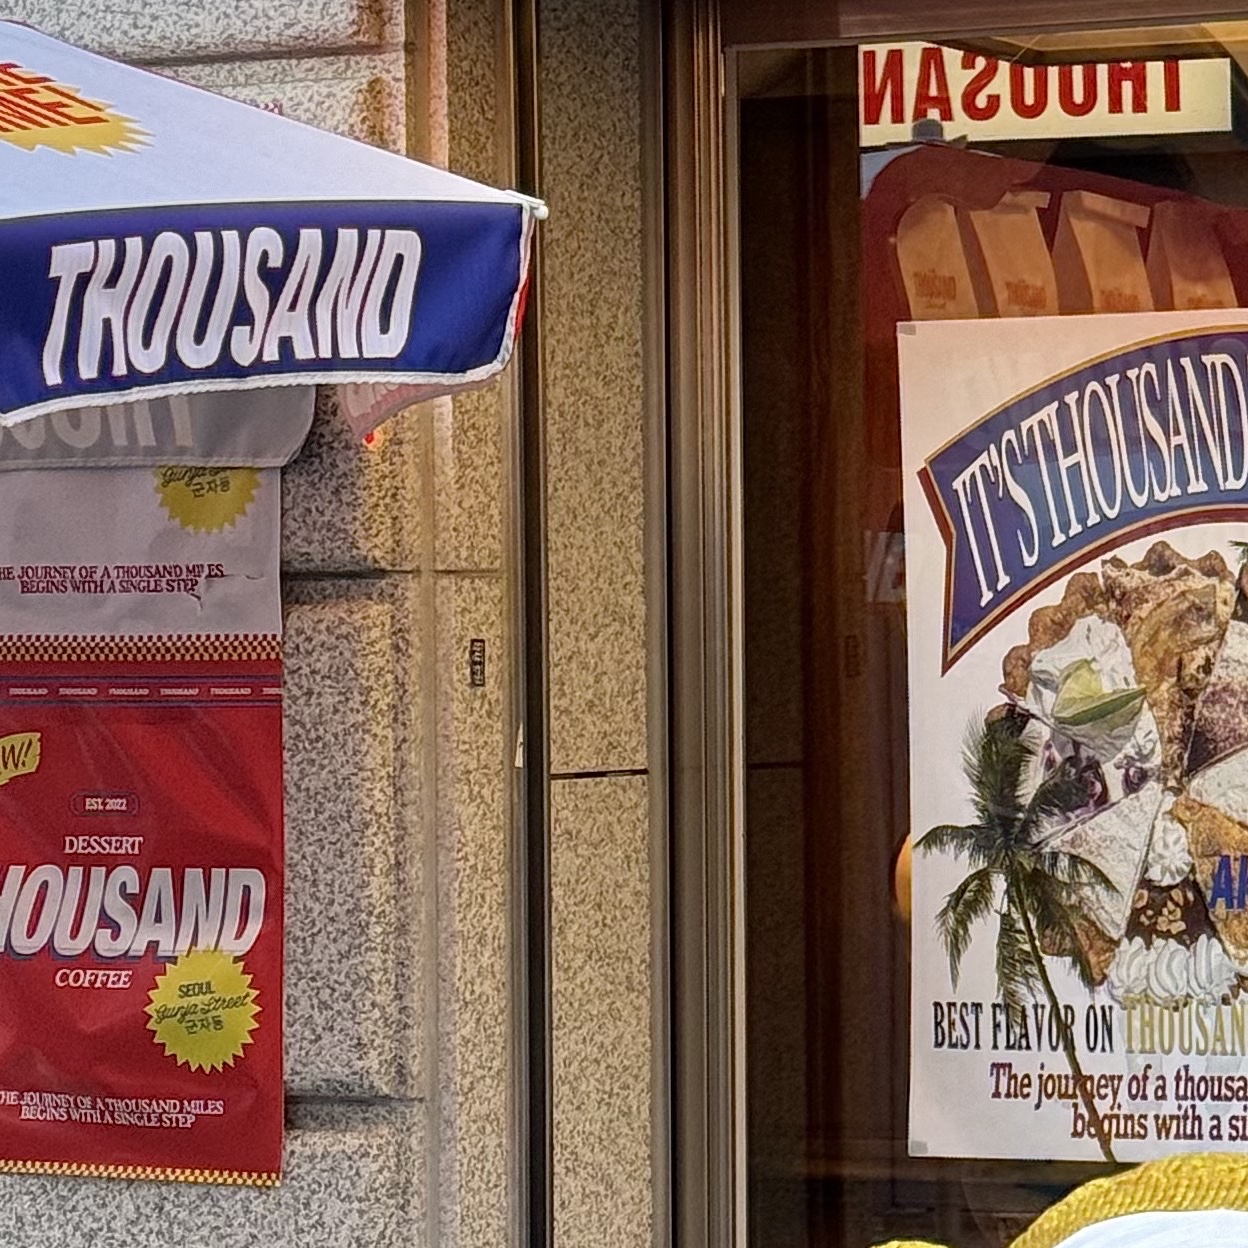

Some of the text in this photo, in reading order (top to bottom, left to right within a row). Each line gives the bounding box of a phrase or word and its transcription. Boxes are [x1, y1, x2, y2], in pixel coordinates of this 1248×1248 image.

[42, 227, 422, 386] THOUSAND
[951, 426, 1041, 608] IT'S
[17, 565, 76, 580] JOURNEY
[79, 565, 98, 580] OF
[101, 565, 111, 579] A
[113, 563, 183, 579] THOUSAND
[20, 579, 69, 594] BEGINS
[70, 580, 105, 594] WITH
[106, 580, 117, 594] A
[118, 579, 163, 594] SINGLE
[63, 835, 144, 855] DESSERT
[54, 968, 133, 989] COFFEE
[178, 980, 216, 999] SEOUL
[932, 1001, 983, 1052] BEST
[991, 1003, 1076, 1053] FLAVOR
[1086, 1004, 1114, 1054] ON
[989, 1062, 1032, 1101] The
[1033, 1069, 1123, 1109] journey
[1127, 1065, 1152, 1102] of
[1153, 1079, 1168, 1102] a
[20, 1091, 77, 1108] JOURNEY
[77, 1095, 93, 1109] OF
[95, 1097, 105, 1111] A
[105, 1098, 180, 1114] THOUSAND
[182, 1099, 225, 1115] MILES
[20, 1105, 197, 1129] BEGINS WITH A SINGLE STEP
[1070, 1103, 1149, 1149] begins
[1153, 1104, 1204, 1142] with
[1208, 1117, 1223, 1141] a
